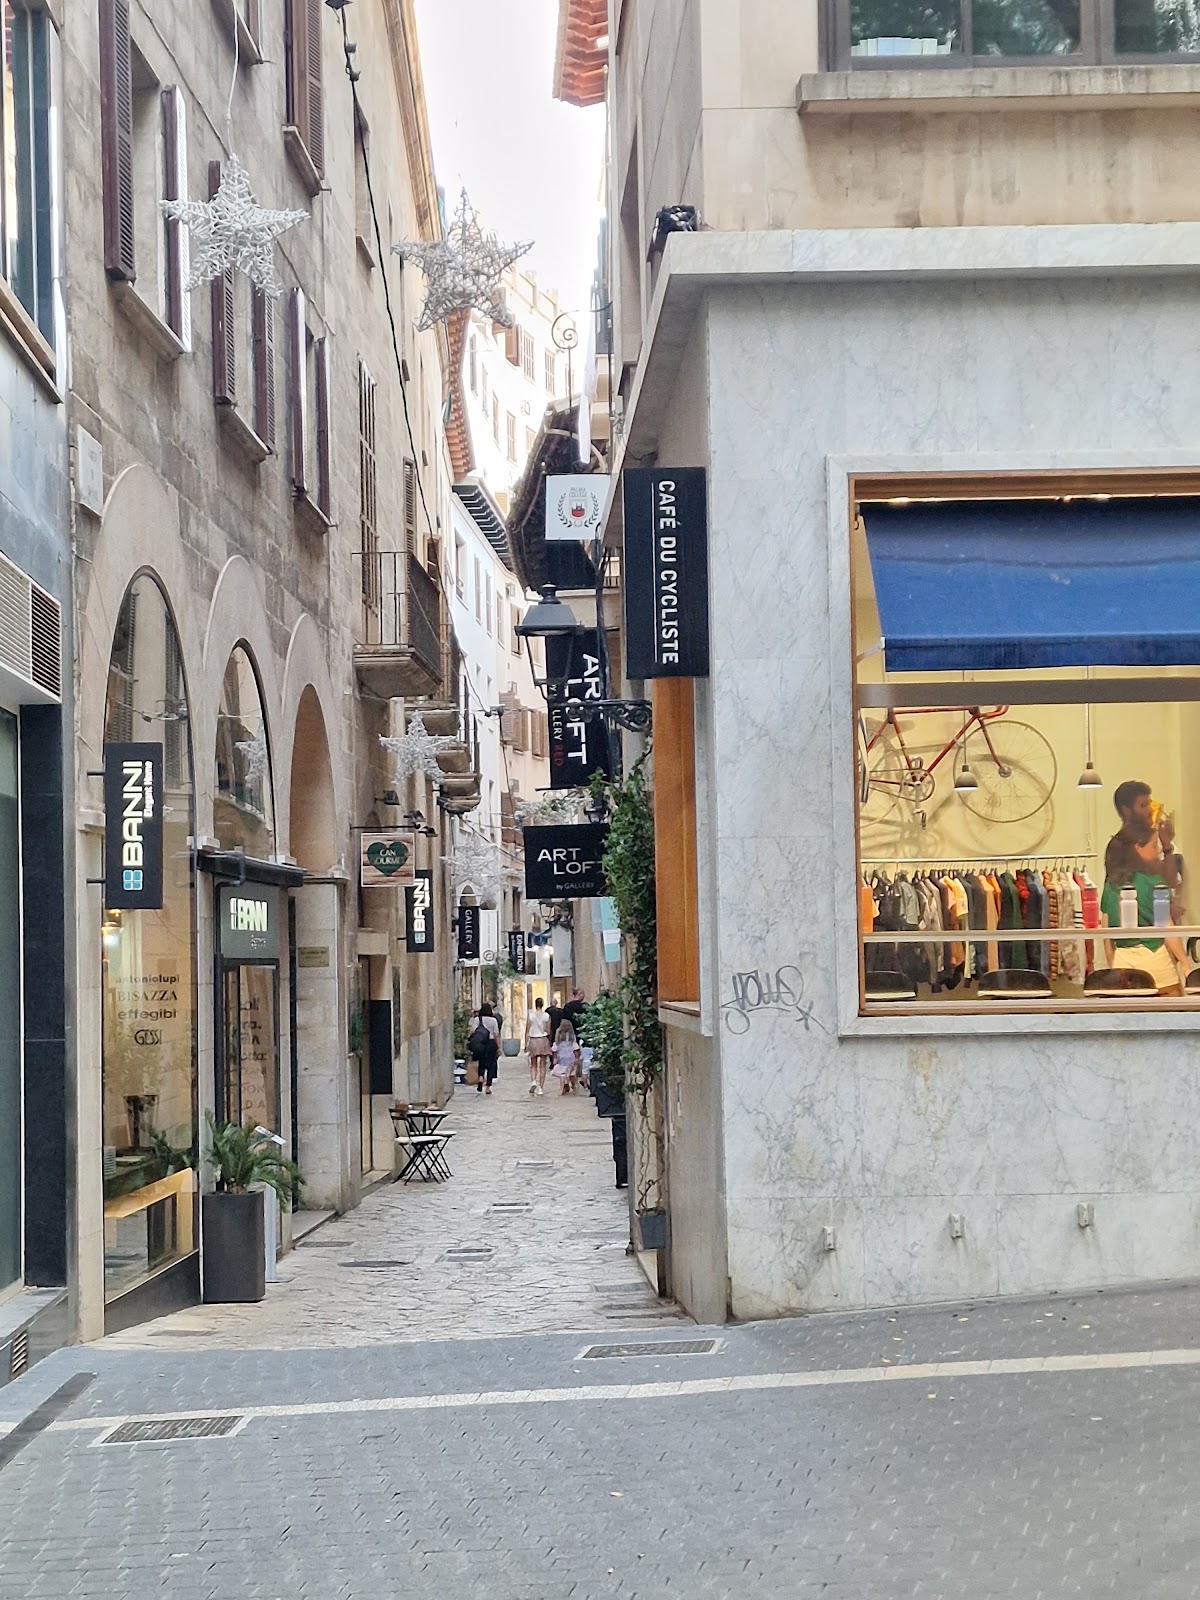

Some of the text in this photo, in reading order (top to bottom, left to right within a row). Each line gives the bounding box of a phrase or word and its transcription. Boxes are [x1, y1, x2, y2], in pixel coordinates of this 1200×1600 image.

[658, 480, 682, 665] CAFÉ DU CYCLISTE
[122, 760, 143, 867] BANNI
[379, 849, 396, 857] CAN
[537, 847, 581, 862] ART
[564, 881, 594, 890] GALLERY
[413, 878, 426, 932] BANNI
[465, 909, 473, 944] GALLERY
[117, 990, 178, 1001] BISAZZA
[118, 1008, 177, 1021] effegibi
